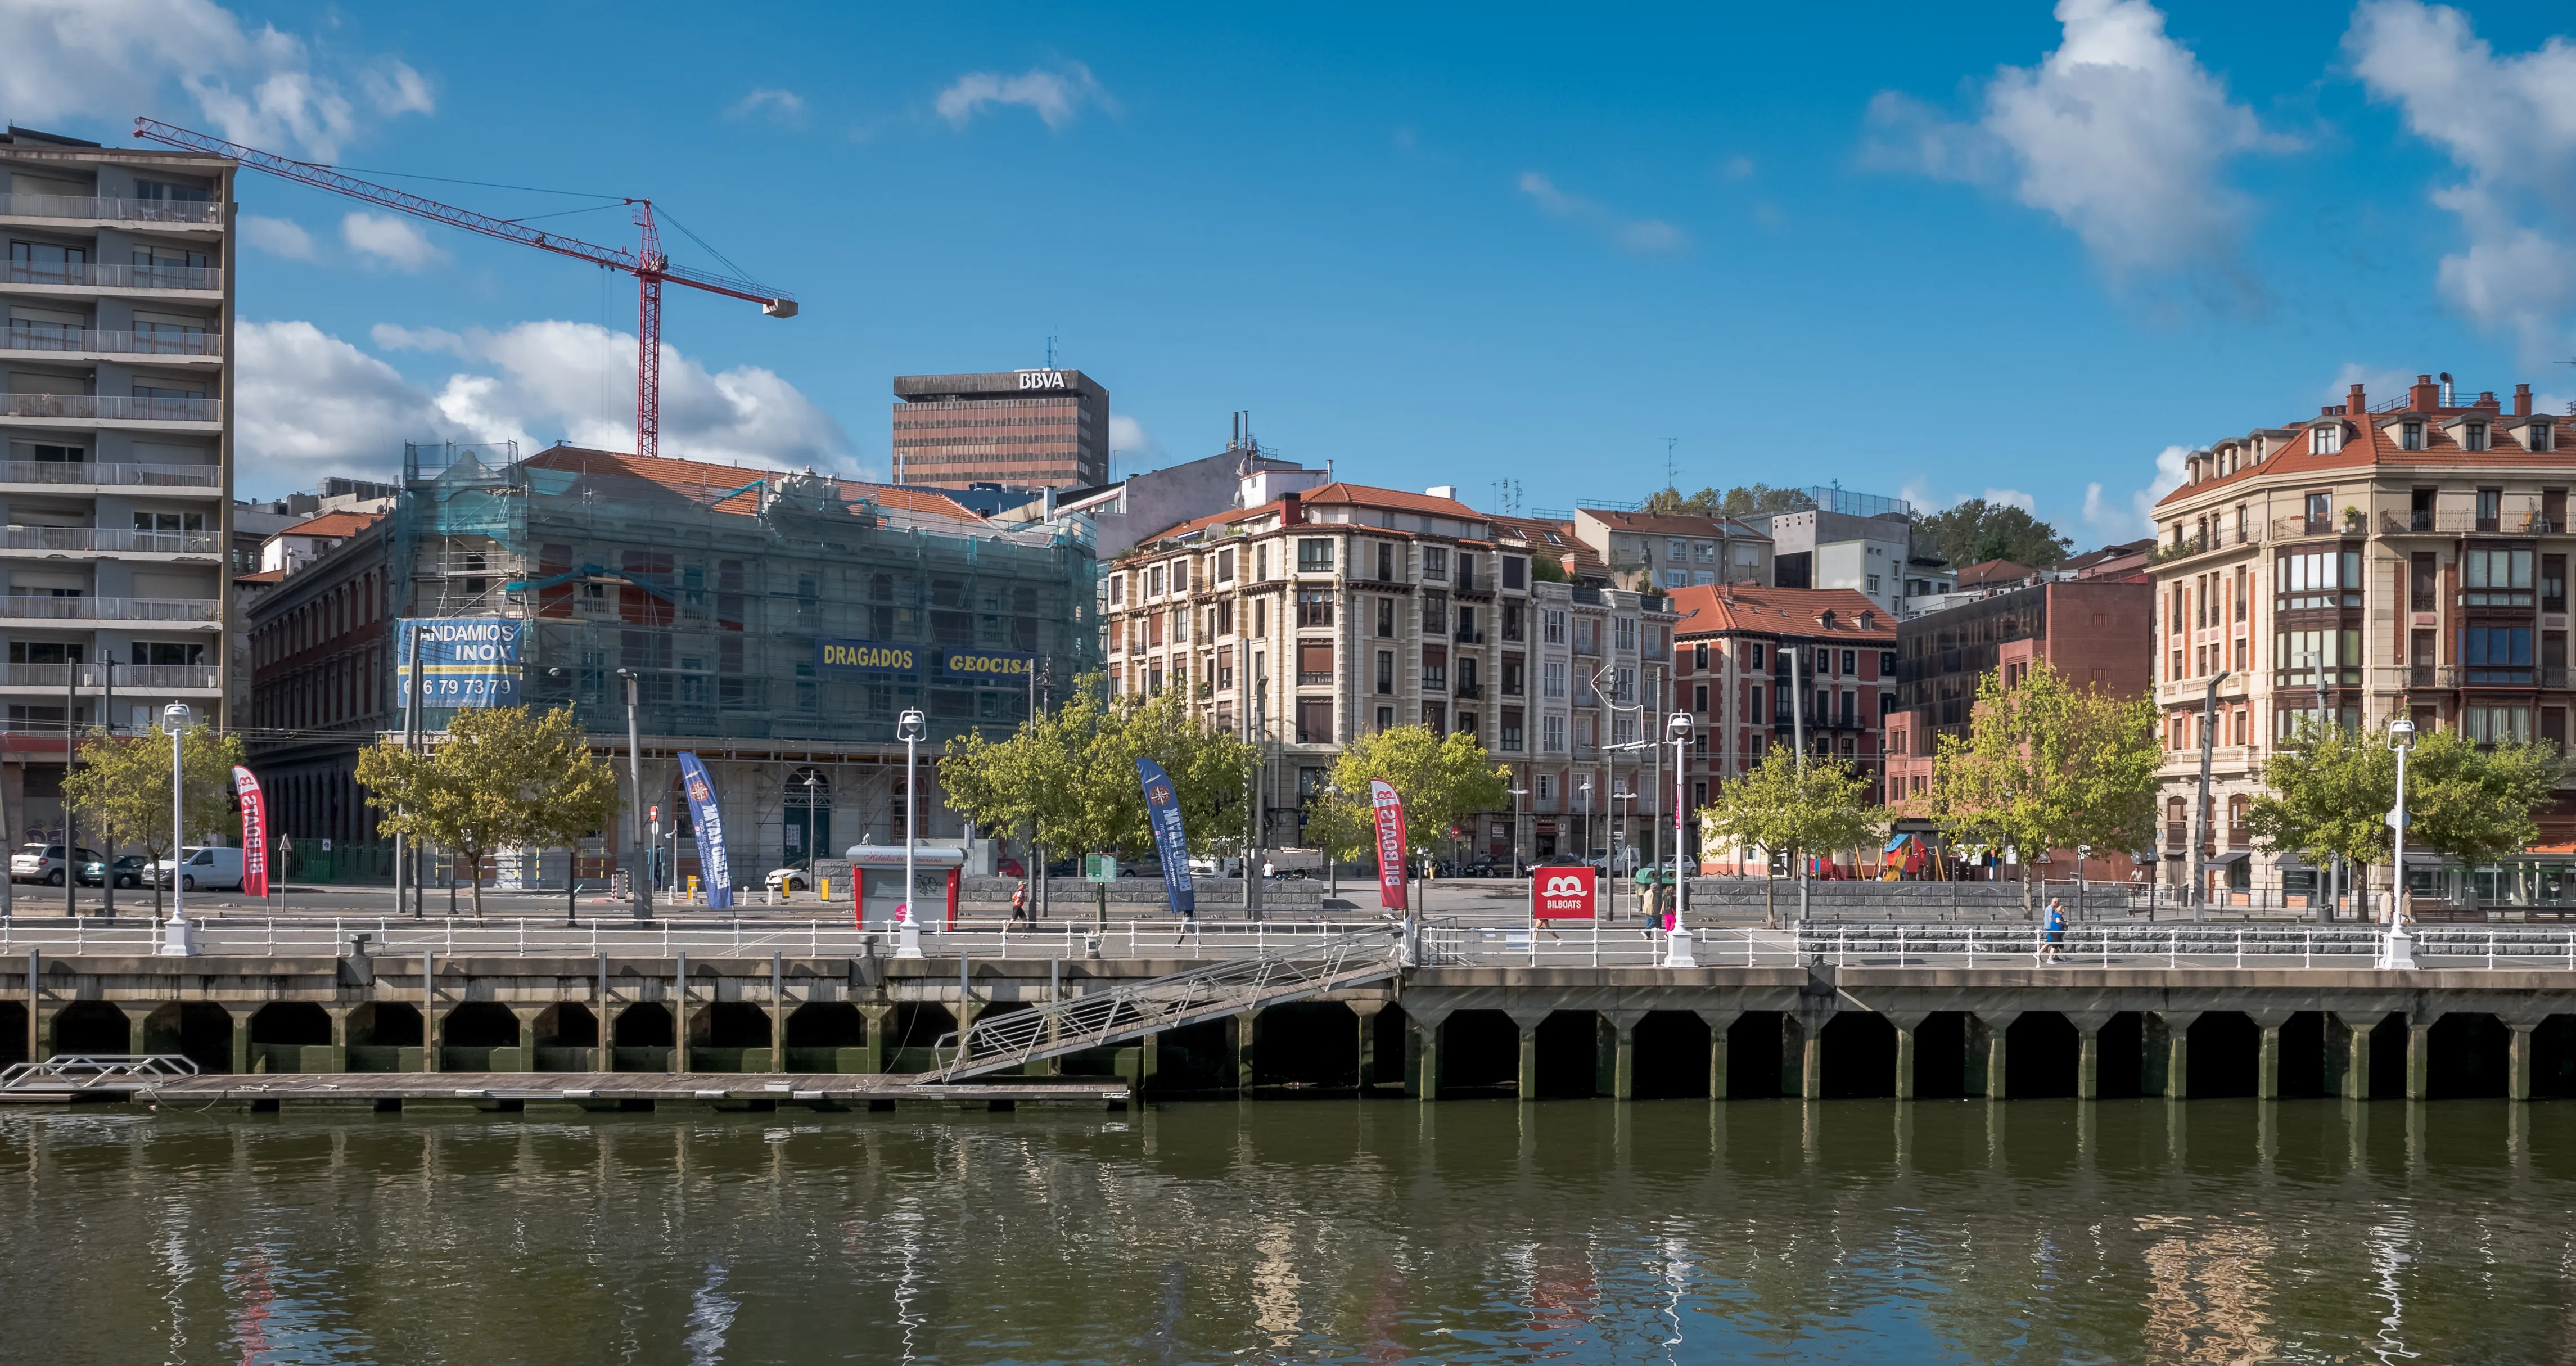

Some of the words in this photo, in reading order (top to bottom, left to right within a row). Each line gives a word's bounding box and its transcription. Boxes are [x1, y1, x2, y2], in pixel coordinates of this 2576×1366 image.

[1019, 372, 1065, 389] BBVA
[421, 624, 515, 642] ANDAMIOS
[455, 644, 513, 661] INOX
[824, 645, 913, 669] DRAGADOS
[950, 655, 1031, 674] GEOCISA
[404, 679, 433, 695] 66
[439, 679, 458, 695] 79
[464, 679, 484, 695] 73
[489, 679, 511, 695] 79
[864, 851, 895, 862] Helados
[1547, 900, 1581, 909] BILBOATS
